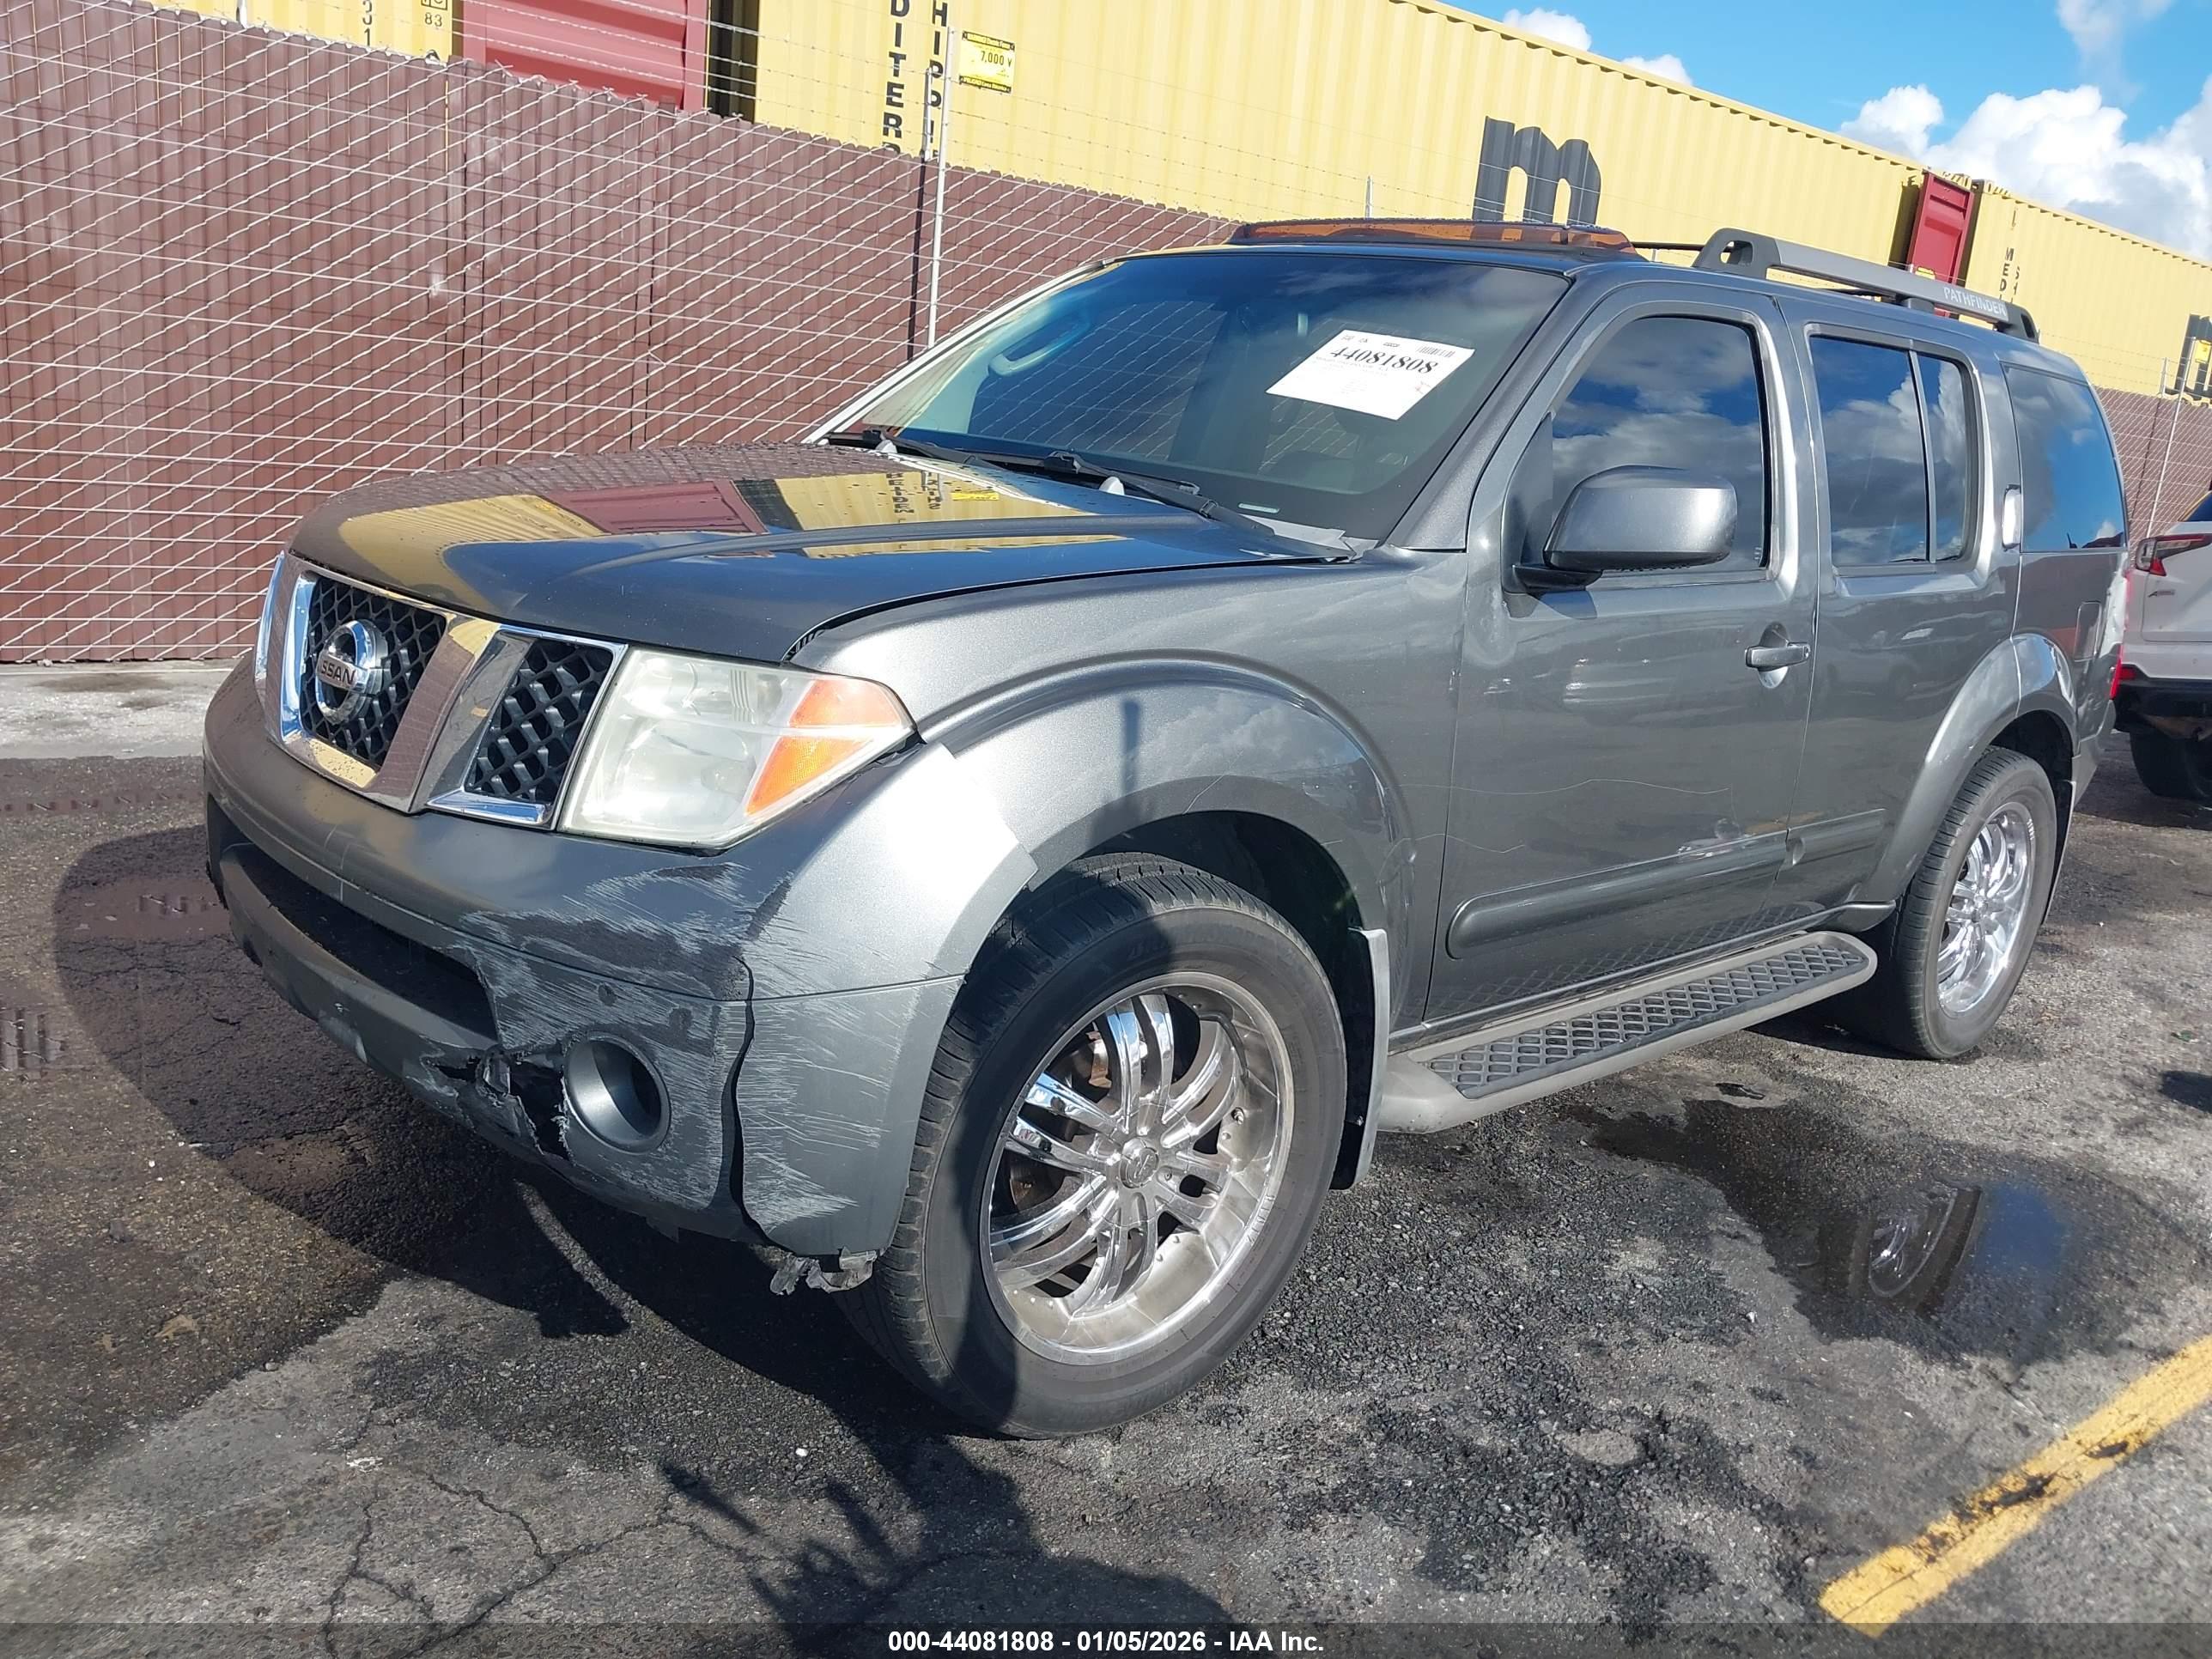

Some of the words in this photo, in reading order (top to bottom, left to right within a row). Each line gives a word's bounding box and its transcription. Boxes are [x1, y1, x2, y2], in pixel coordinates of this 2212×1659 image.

[424, 12, 442, 27] 83
[1942, 287, 2008, 317] PATHFINDER
[1330, 346, 1438, 374] 44081808
